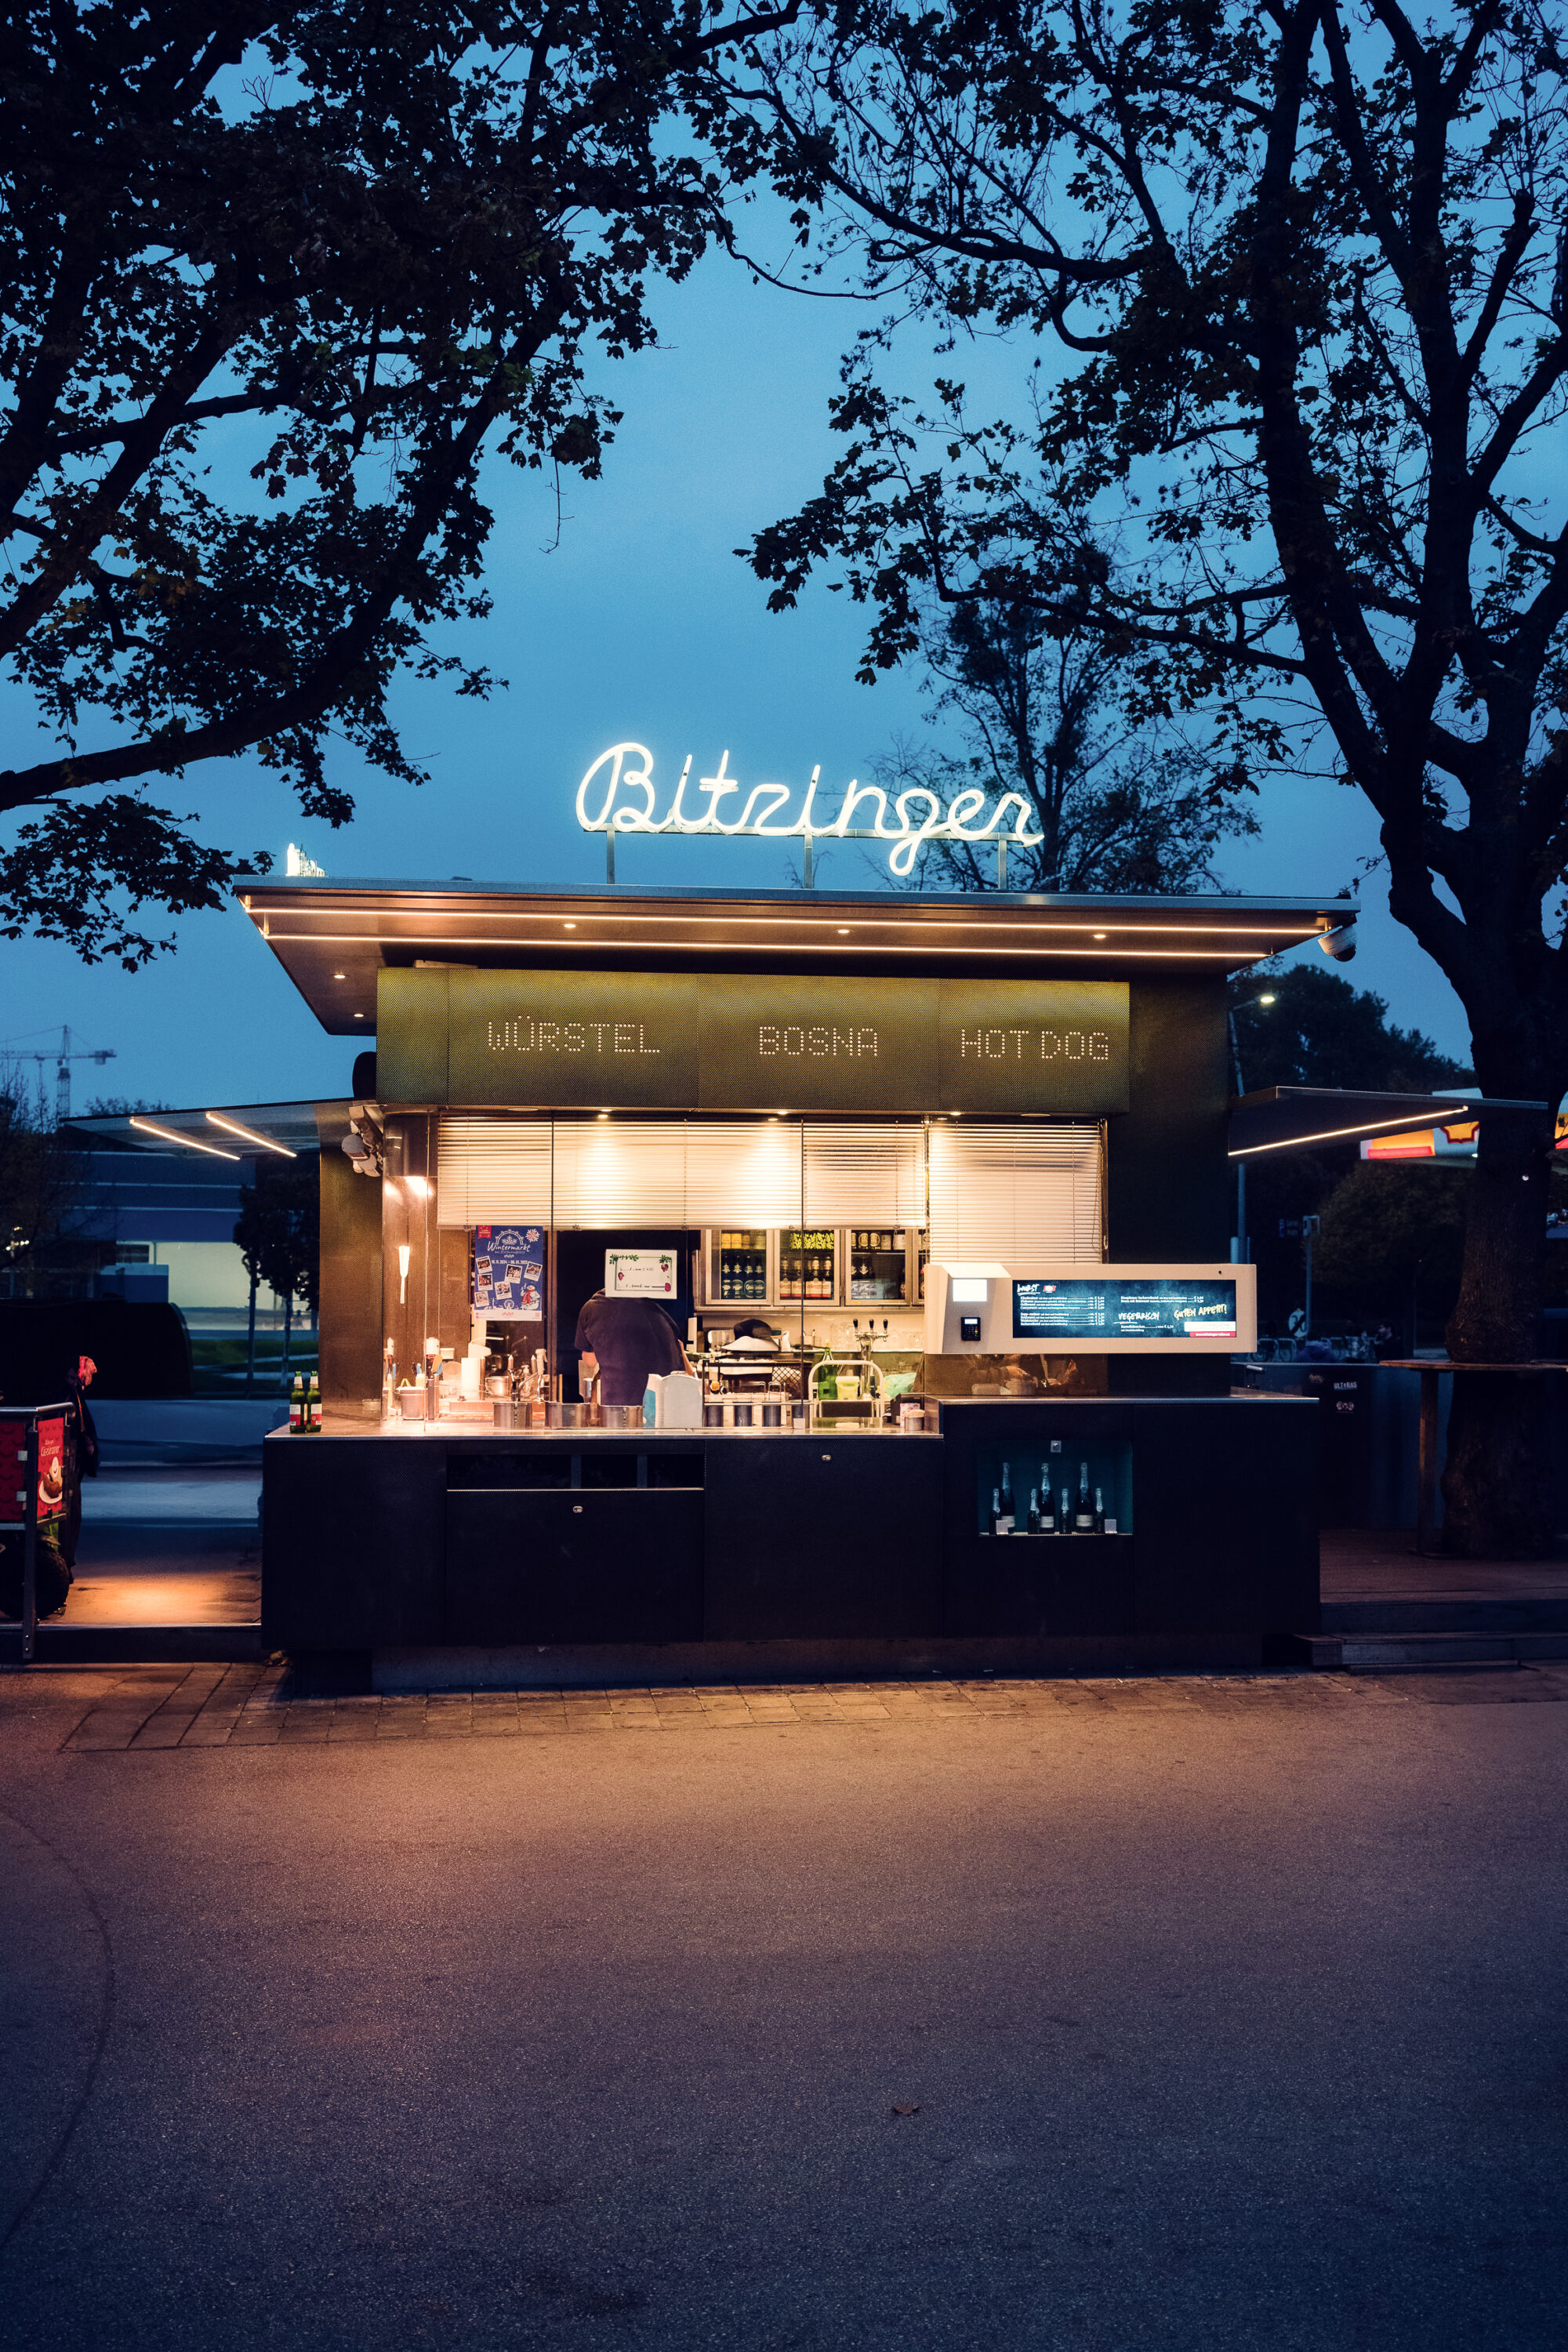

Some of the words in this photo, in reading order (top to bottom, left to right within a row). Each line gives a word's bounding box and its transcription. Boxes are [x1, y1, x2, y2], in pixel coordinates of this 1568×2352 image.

[575, 742, 1045, 877] Bitzinger
[488, 1014, 661, 1053] WÜRSTEL
[759, 1026, 877, 1057] BOSNA
[961, 1029, 1029, 1058] HOT
[1041, 1030, 1109, 1060] DOG
[487, 1241, 531, 1252] Wintermarkt
[1118, 1312, 1160, 1322] VEGETARISCH
[1174, 1308, 1196, 1320] GUTEN
